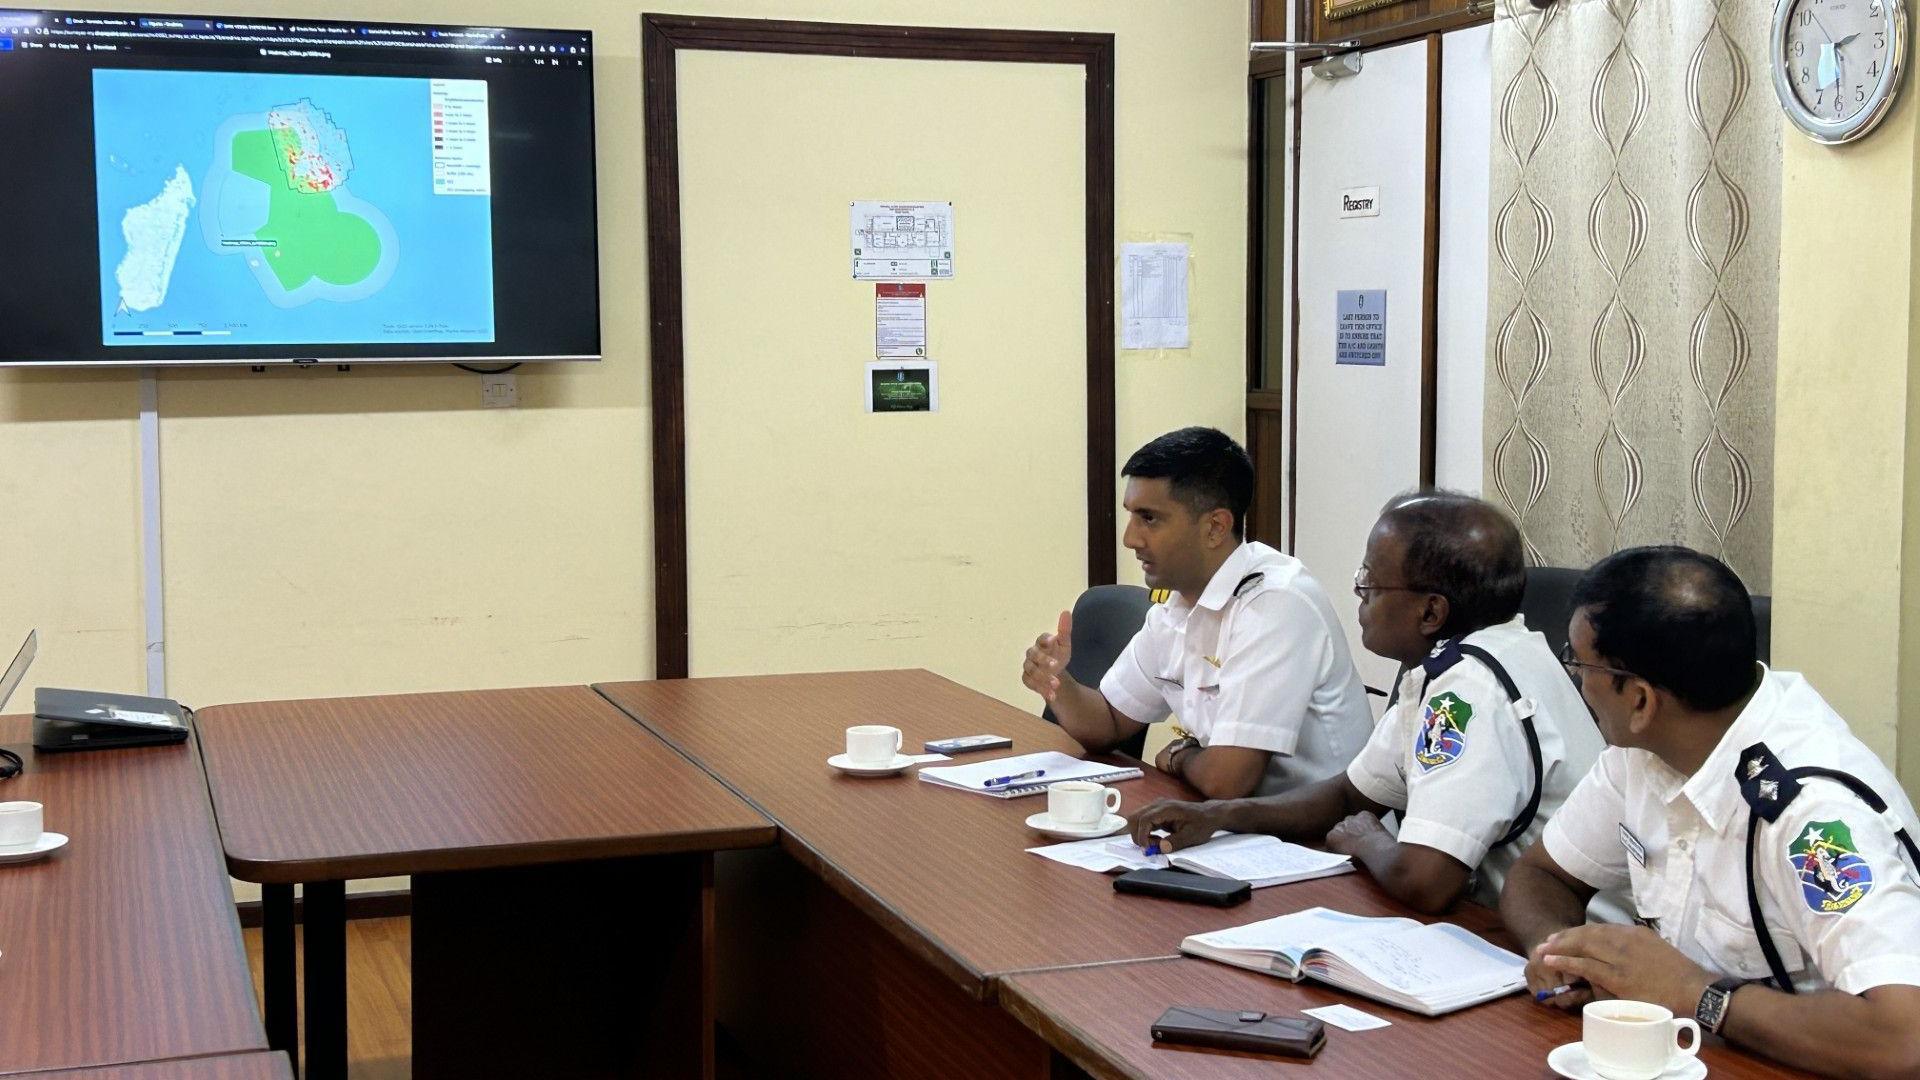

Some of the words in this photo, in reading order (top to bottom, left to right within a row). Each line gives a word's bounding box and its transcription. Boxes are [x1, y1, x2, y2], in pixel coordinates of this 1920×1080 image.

[1800, 10, 1812, 26] 10
[1869, 2, 1878, 18] 2
[1794, 41, 1804, 57] 9
[1874, 32, 1884, 49] 3
[1801, 67, 1810, 84] 8
[1867, 60, 1880, 77] 4
[1816, 88, 1824, 104] 7
[1856, 85, 1864, 102] 5
[1834, 94, 1844, 112] 6
